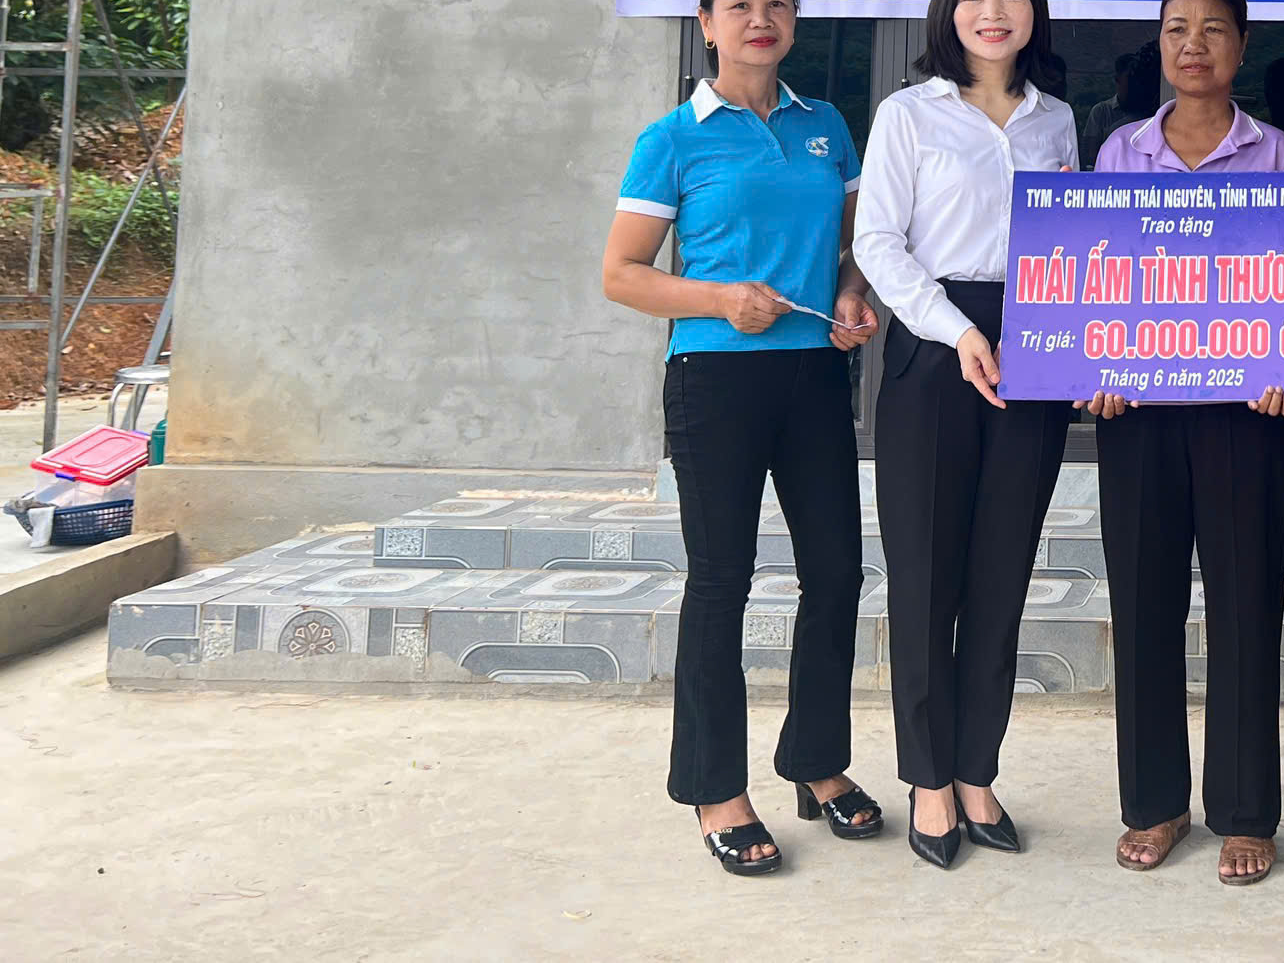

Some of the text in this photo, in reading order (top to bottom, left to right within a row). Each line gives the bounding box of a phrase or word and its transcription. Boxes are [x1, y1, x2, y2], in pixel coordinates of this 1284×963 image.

[1026, 188, 1052, 208] TYM
[1064, 189, 1085, 208] CHI
[1087, 185, 1131, 208] NHÁNH
[1134, 185, 1161, 208] THÁI
[1163, 185, 1216, 210] NGUYÊN,
[1219, 182, 1248, 208] TỈNH
[1250, 184, 1278, 207] THÁI
[1140, 216, 1214, 237] Trao tặng
[1016, 245, 1076, 304] MÁI
[1081, 240, 1132, 304] ẤM
[1139, 246, 1208, 303] TÌNH
[1020, 331, 1042, 352] Trị
[1045, 330, 1076, 352] giá:
[1083, 319, 1271, 359] 60.000.000
[1099, 368, 1245, 391] Tháng 6 năm 2025
